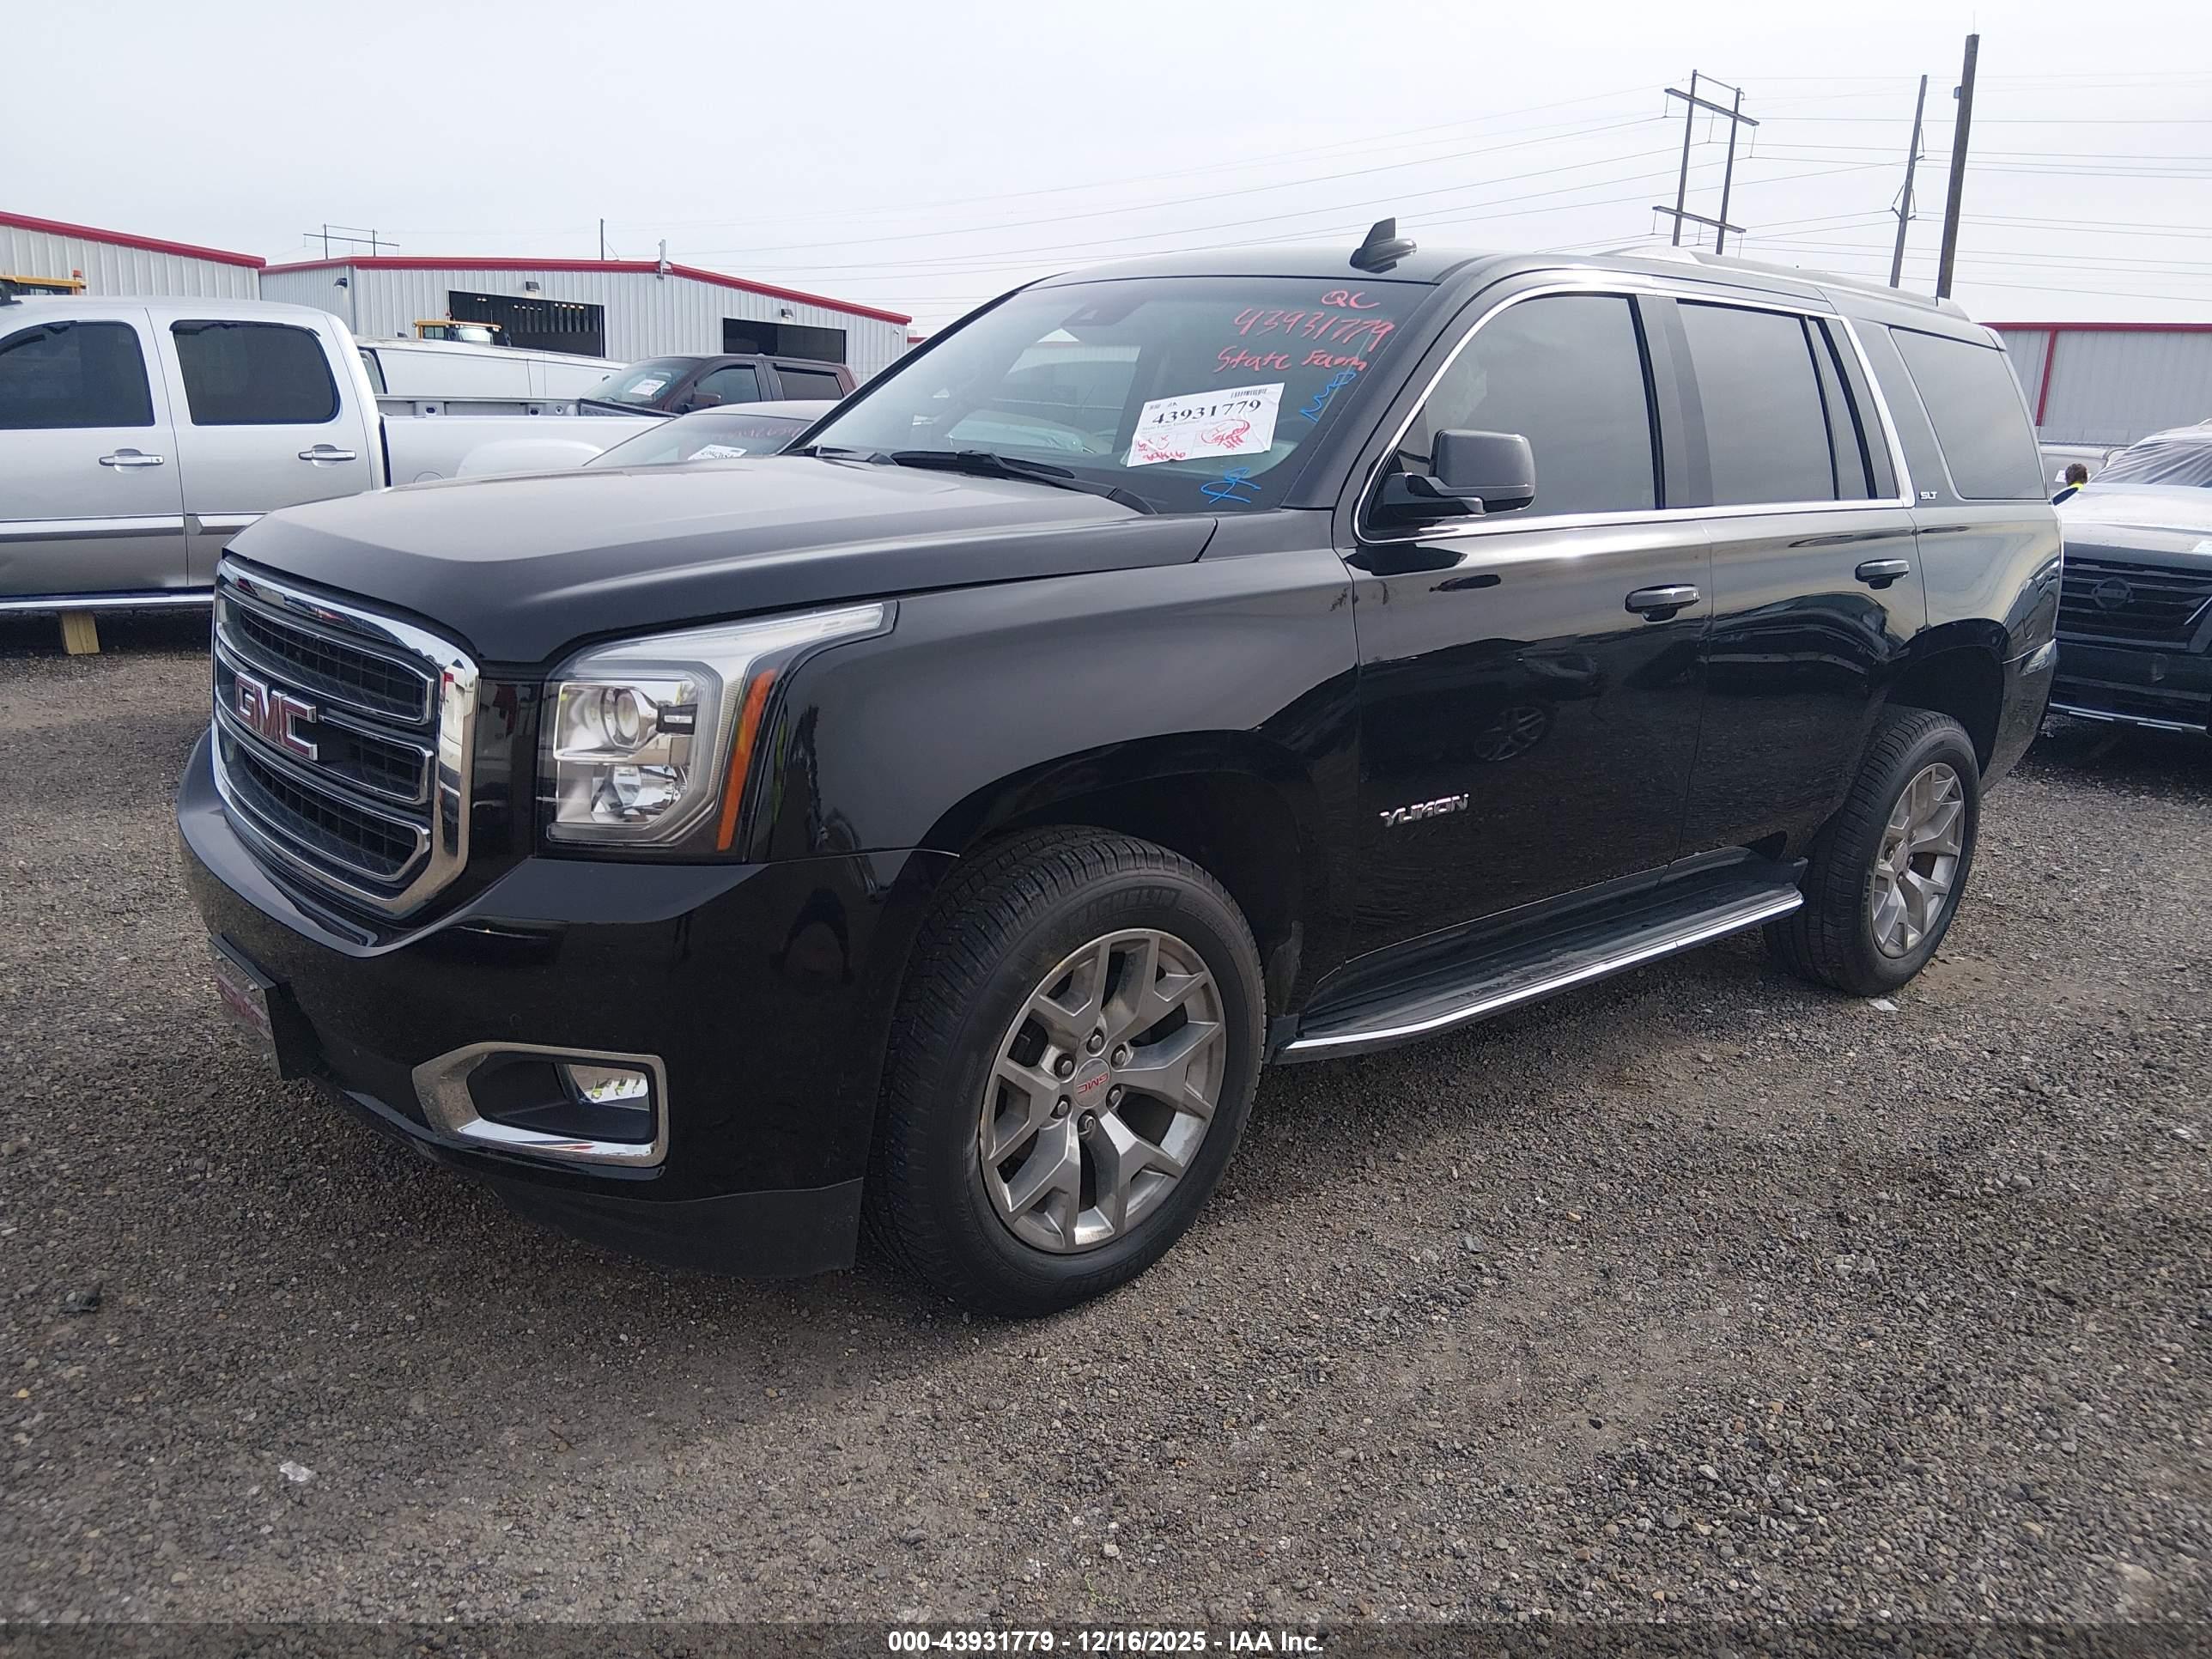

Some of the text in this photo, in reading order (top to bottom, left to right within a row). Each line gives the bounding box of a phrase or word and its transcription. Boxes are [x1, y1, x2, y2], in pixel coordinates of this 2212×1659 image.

[1321, 290, 1381, 309] QC
[1234, 308, 1395, 353] 43931779
[1152, 399, 1261, 425] 43931779
[1919, 490, 1938, 500] SLT
[234, 671, 318, 762] GMC
[1379, 793, 1469, 828] YUKON
[1077, 1072, 1109, 1094] GMC
